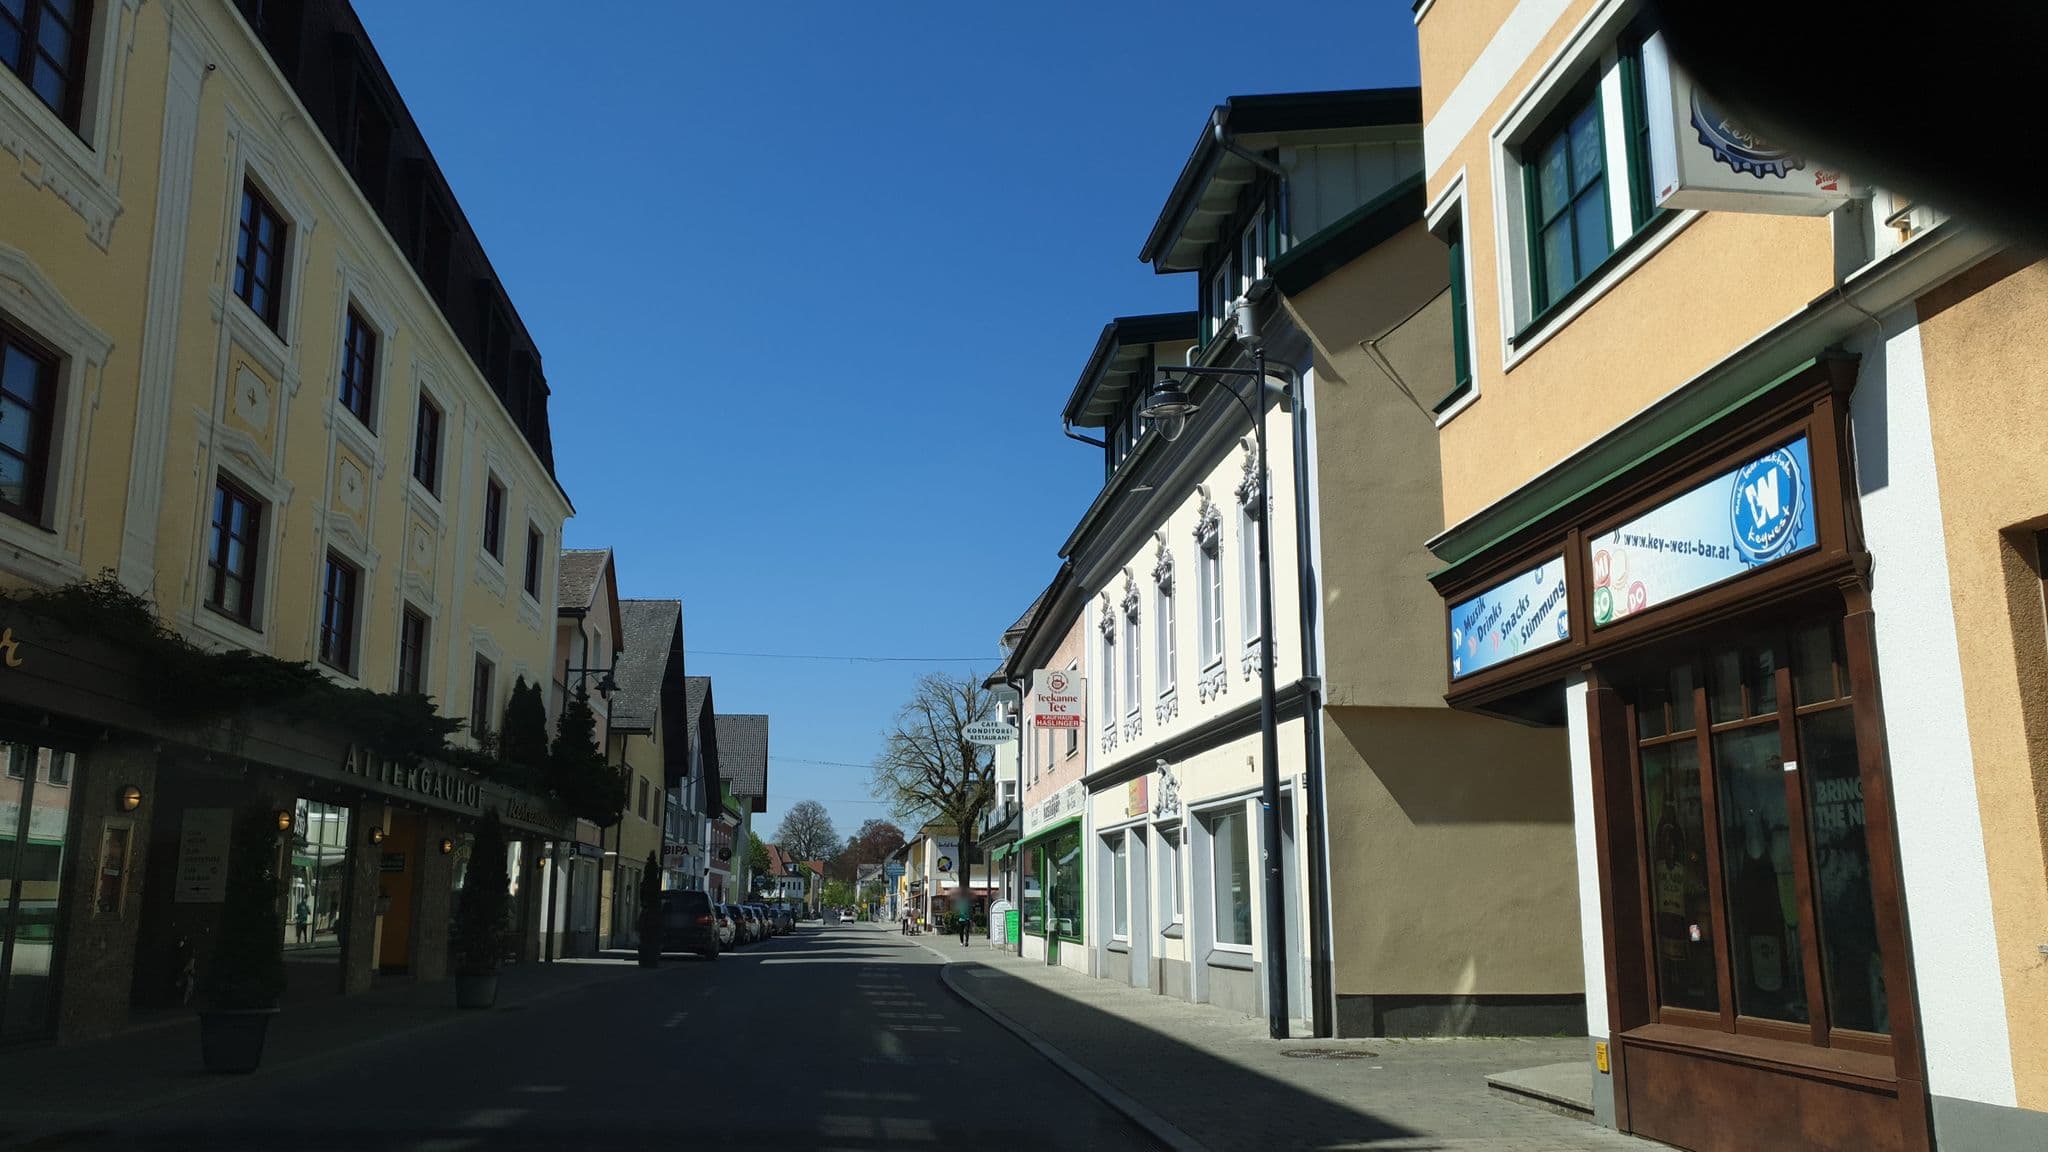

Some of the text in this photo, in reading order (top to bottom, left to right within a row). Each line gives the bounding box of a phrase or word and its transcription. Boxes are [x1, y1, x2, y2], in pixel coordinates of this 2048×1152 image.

[1624, 532, 1730, 561] www.key-west-bar.at
[1463, 596, 1486, 636] Musik
[1500, 594, 1530, 641] Snacks
[1520, 578, 1566, 645] Stimmung
[1477, 601, 1502, 642] Drinks
[1037, 693, 1079, 703] Teekanne
[1048, 702, 1067, 712] Tee
[967, 727, 1013, 735] KONDITOREI
[1036, 719, 1079, 727] HASLINGER
[664, 845, 690, 855] BIPA
